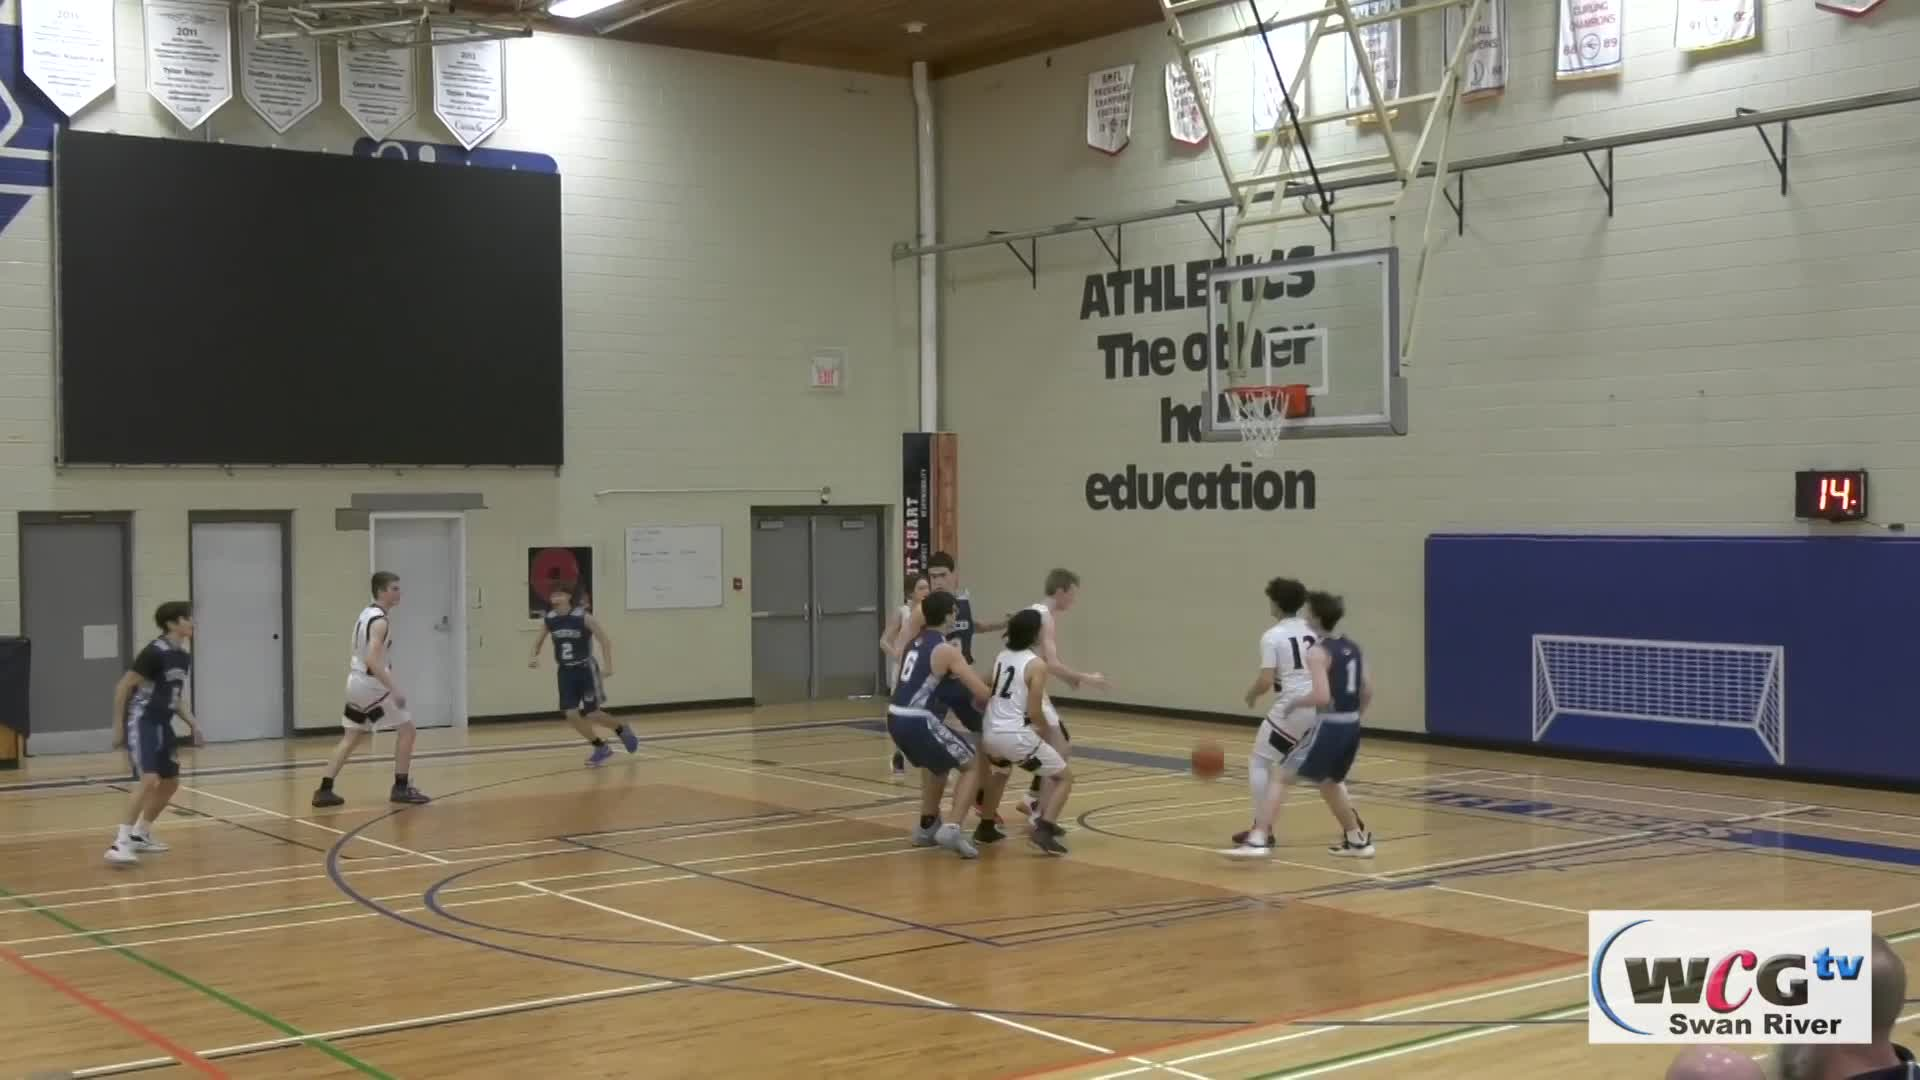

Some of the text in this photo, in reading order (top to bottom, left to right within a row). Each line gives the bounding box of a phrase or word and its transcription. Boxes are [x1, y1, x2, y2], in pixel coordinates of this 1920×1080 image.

[176, 27, 198, 37] 2011
[1097, 332, 1176, 379] The
[1085, 461, 1316, 511] education
[906, 497, 919, 550] CHART
[991, 661, 1015, 699] 12
[1345, 658, 1357, 692] 1
